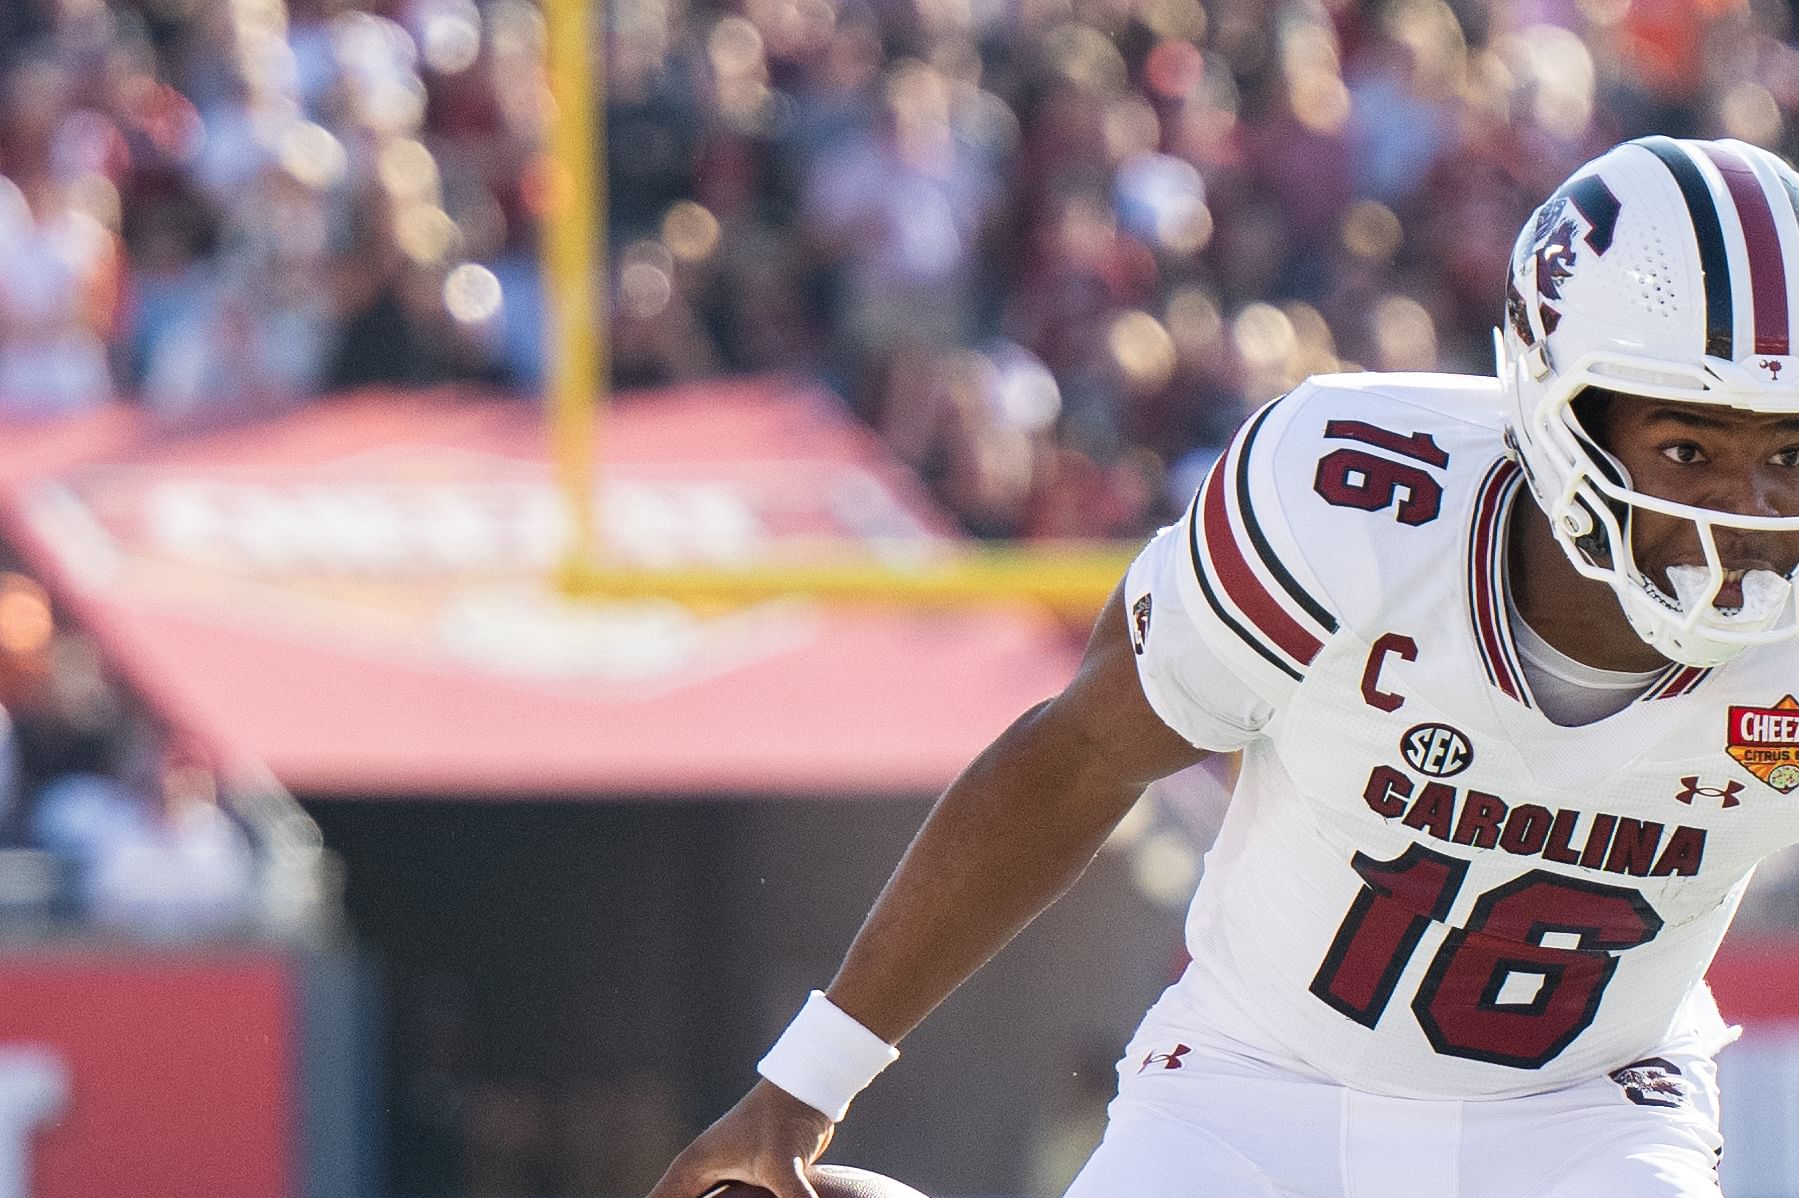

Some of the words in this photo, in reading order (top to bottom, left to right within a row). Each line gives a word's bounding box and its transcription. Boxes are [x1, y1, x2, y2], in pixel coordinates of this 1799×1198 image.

[1313, 419, 1450, 527] 16
[1361, 632, 1419, 713] C
[1406, 726, 1468, 775] SEC
[1743, 750, 1790, 762] CITRUS
[1363, 764, 1708, 878] CAROLINA
[1308, 841, 1665, 1070] 16
